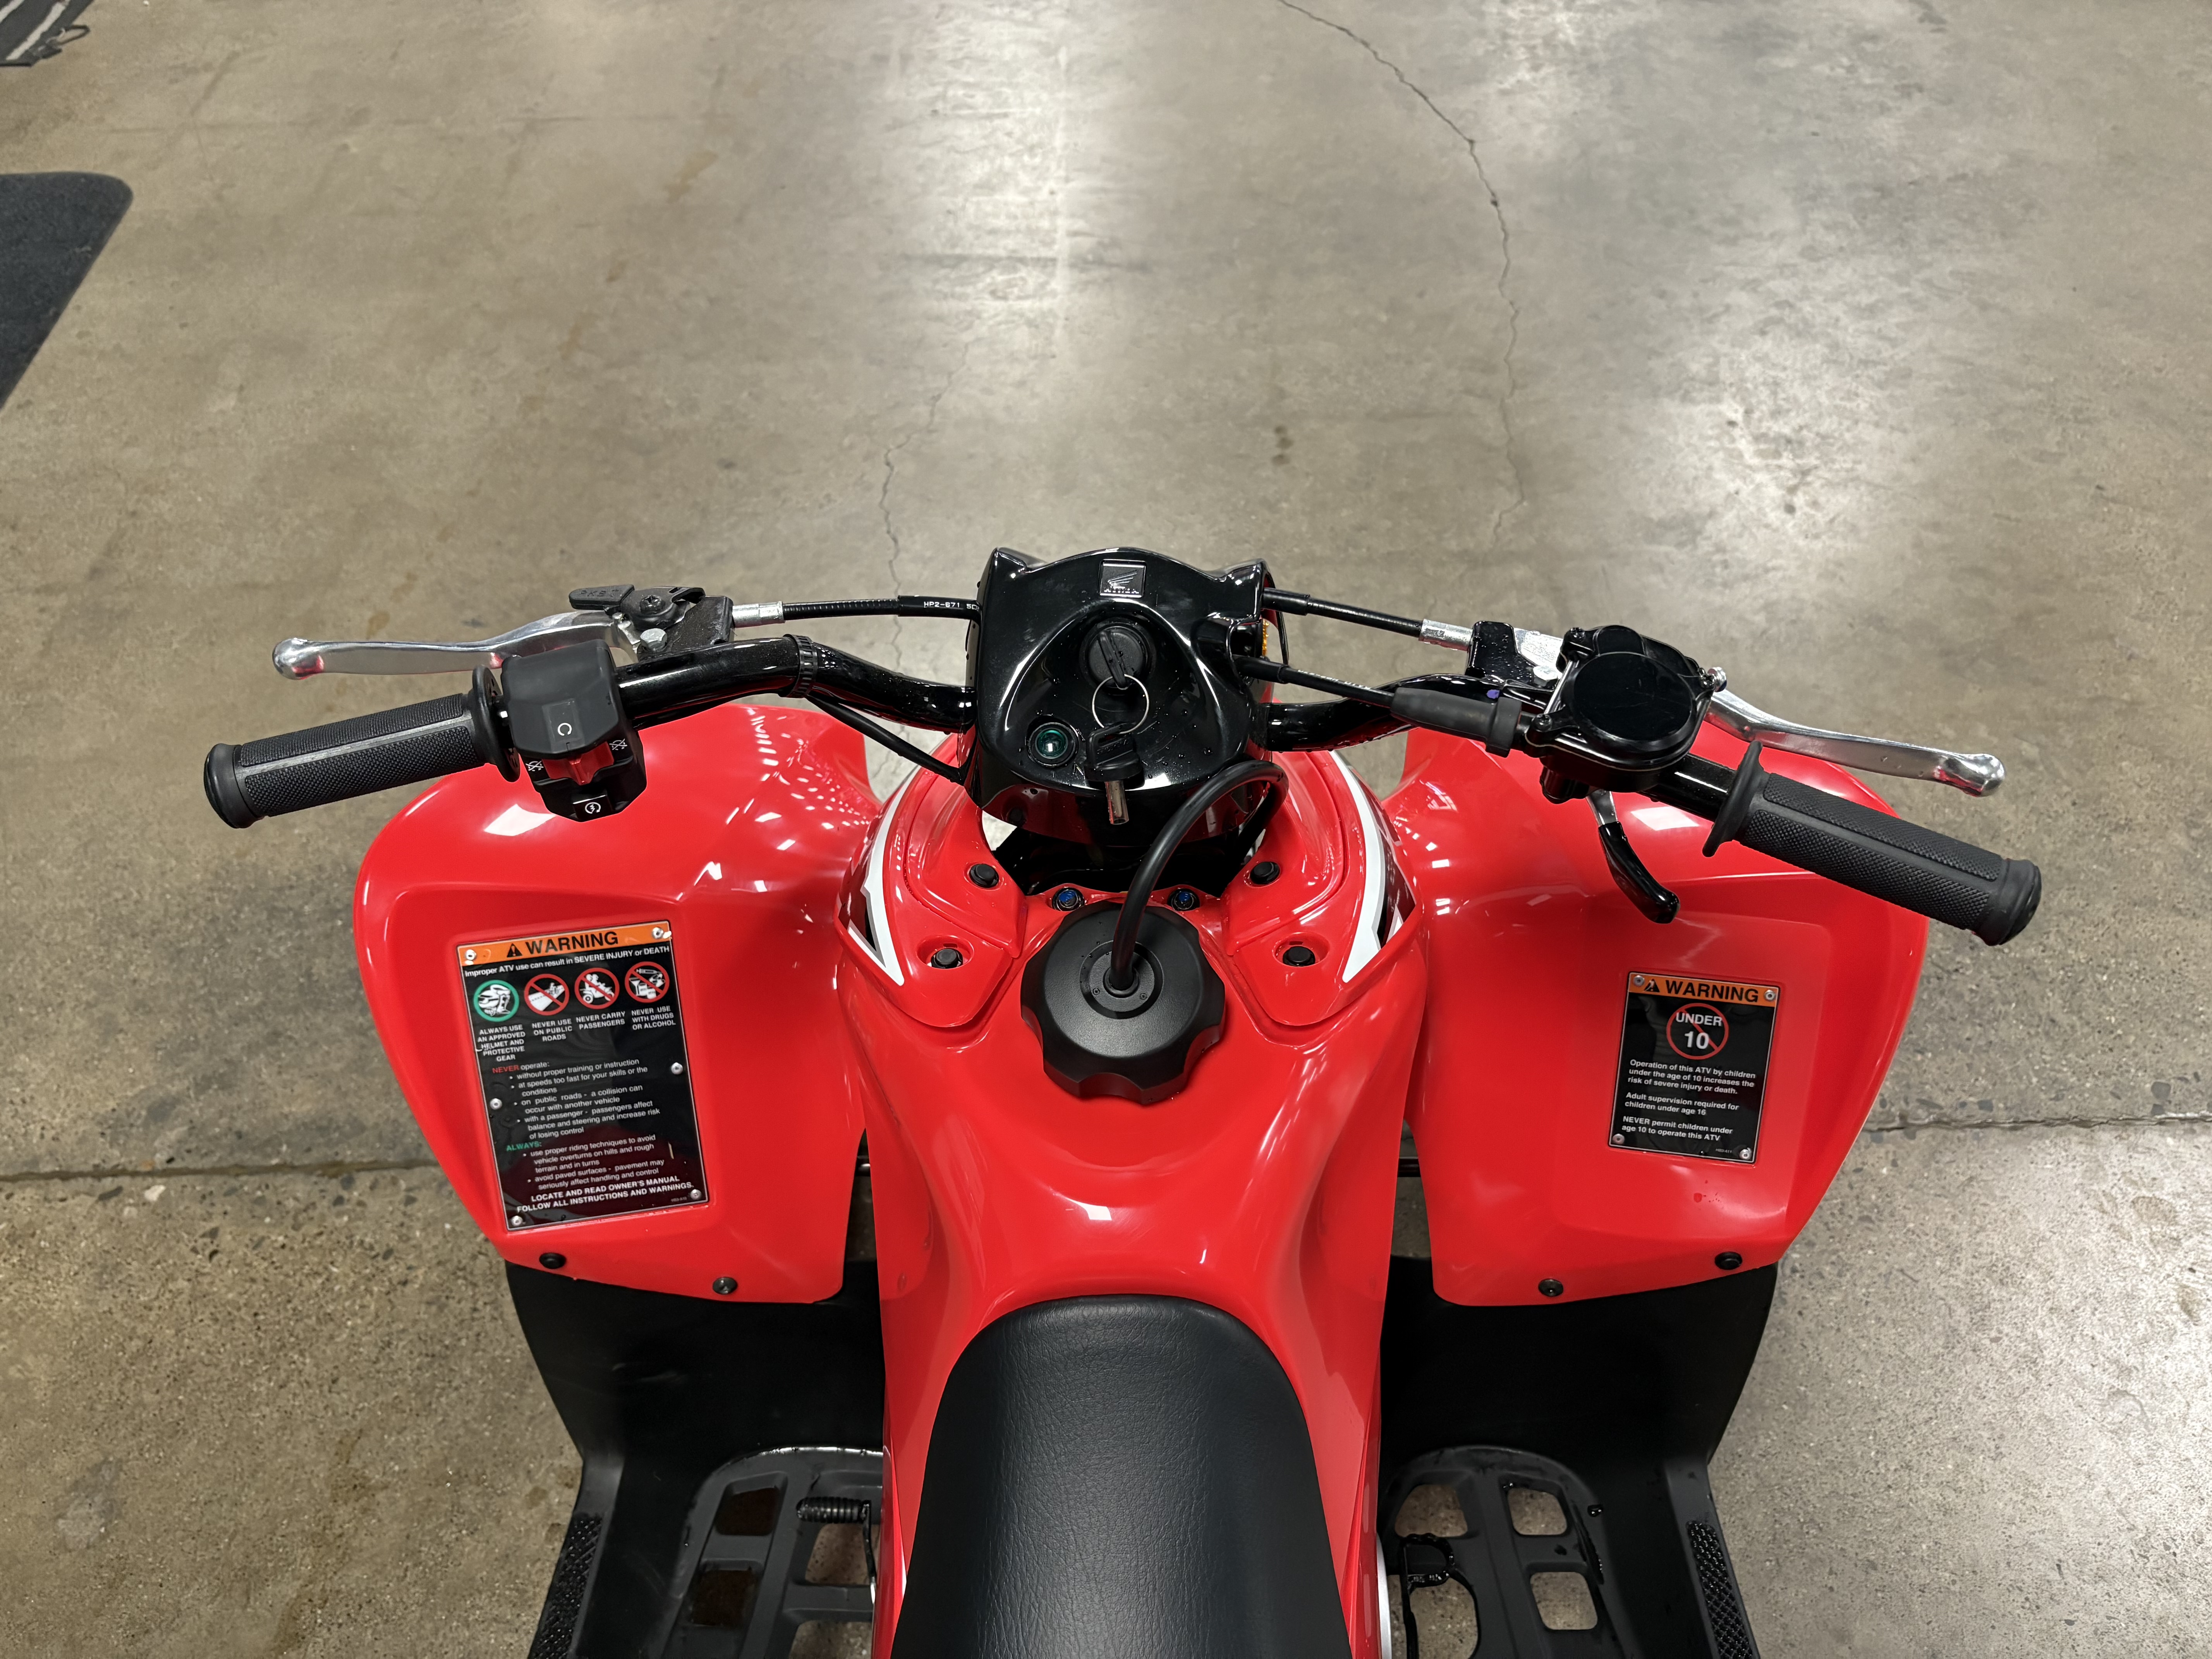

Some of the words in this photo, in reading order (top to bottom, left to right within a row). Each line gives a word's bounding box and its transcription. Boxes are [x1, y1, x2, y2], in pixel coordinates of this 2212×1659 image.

[526, 931, 618, 954] WARNING
[465, 968, 497, 977] Improper
[544, 958, 565, 967] result
[574, 953, 605, 963] SEVERE
[606, 950, 633, 959] INJURY
[644, 946, 669, 955] DEATH
[1666, 980, 1759, 1002] WARNING
[576, 1014, 599, 1022] NEVER
[601, 1011, 625, 1019] CARRY
[650, 1012, 673, 1020] DRUGS
[1676, 1012, 1723, 1026] UNDER
[479, 1026, 508, 1035] ALWAYS
[546, 1025, 572, 1034] PUBLIC
[579, 1018, 625, 1029] PASSENGERS
[644, 1020, 676, 1029] ALCOHOL
[489, 1031, 525, 1041] APPROVED
[1684, 1031, 1709, 1049] 10
[481, 1041, 508, 1050] HELMET
[483, 1046, 524, 1056] PROTECTIVE
[492, 1065, 519, 1073] NEVER
[517, 1071, 541, 1079] without
[543, 1068, 565, 1077] proper
[604, 1059, 639, 1068] instruction
[1630, 1059, 1667, 1069] Operation
[1724, 1070, 1755, 1078] children
[527, 1079, 552, 1087] speeds
[592, 1072, 607, 1080] your
[1680, 1082, 1702, 1091] injury
[1703, 1076, 1740, 1085] increases
[522, 1087, 557, 1096] conditions
[535, 1096, 557, 1105] public
[598, 1087, 627, 1096] collision
[1626, 1092, 1646, 1100] Adult
[1648, 1096, 1692, 1105] supervision
[564, 1100, 592, 1108] another
[594, 1096, 620, 1105] vehicle
[1625, 1101, 1655, 1109] children
[546, 1110, 583, 1121] passenger
[591, 1104, 632, 1115] passengers
[634, 1100, 653, 1108] affect
[527, 1123, 555, 1131] balance
[572, 1117, 600, 1125] steering
[617, 1111, 646, 1119] increase
[1623, 1116, 1650, 1124] NEVER
[1678, 1123, 1708, 1131] children
[560, 1126, 584, 1135] control
[544, 1147, 567, 1156] proper
[589, 1139, 627, 1149] techniques
[637, 1134, 656, 1142] avoid
[534, 1156, 558, 1166] vehicle
[560, 1152, 592, 1161] overturns
[535, 1173, 553, 1182] avoid
[555, 1170, 576, 1180] paved
[577, 1167, 606, 1175] surfaces
[615, 1161, 648, 1172] pavement
[538, 1180, 568, 1190] seriously
[635, 1167, 659, 1176] control
[531, 1191, 563, 1202] LOCATE
[566, 1188, 582, 1197] AND
[584, 1185, 606, 1194] READ
[608, 1180, 644, 1191] OWNER'S
[646, 1175, 680, 1185] MANUAL
[517, 1202, 550, 1212] FOLLOW
[570, 1191, 628, 1204] INSTRUCTIONS
[630, 1188, 647, 1196] AND
